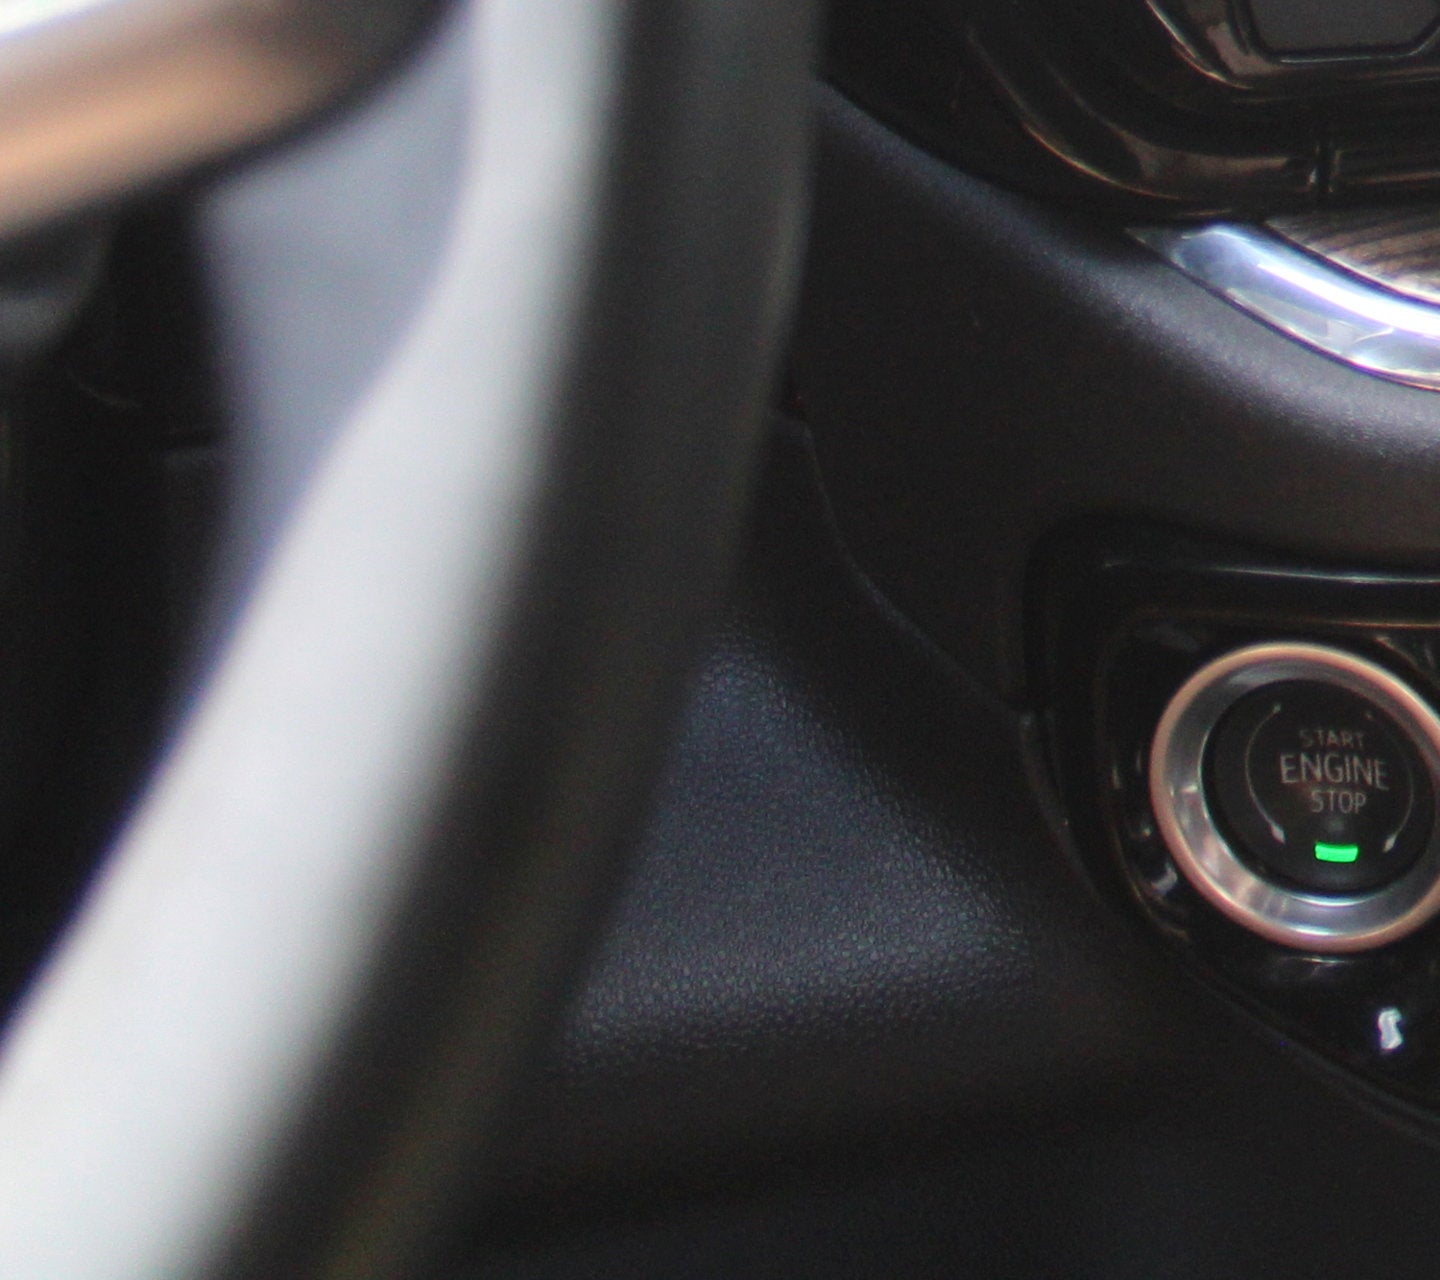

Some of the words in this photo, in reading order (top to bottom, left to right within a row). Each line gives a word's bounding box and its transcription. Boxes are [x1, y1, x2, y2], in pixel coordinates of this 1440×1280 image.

[1299, 728, 1366, 749] START
[1279, 751, 1390, 792] ENGINE
[1309, 787, 1368, 815] STOP
